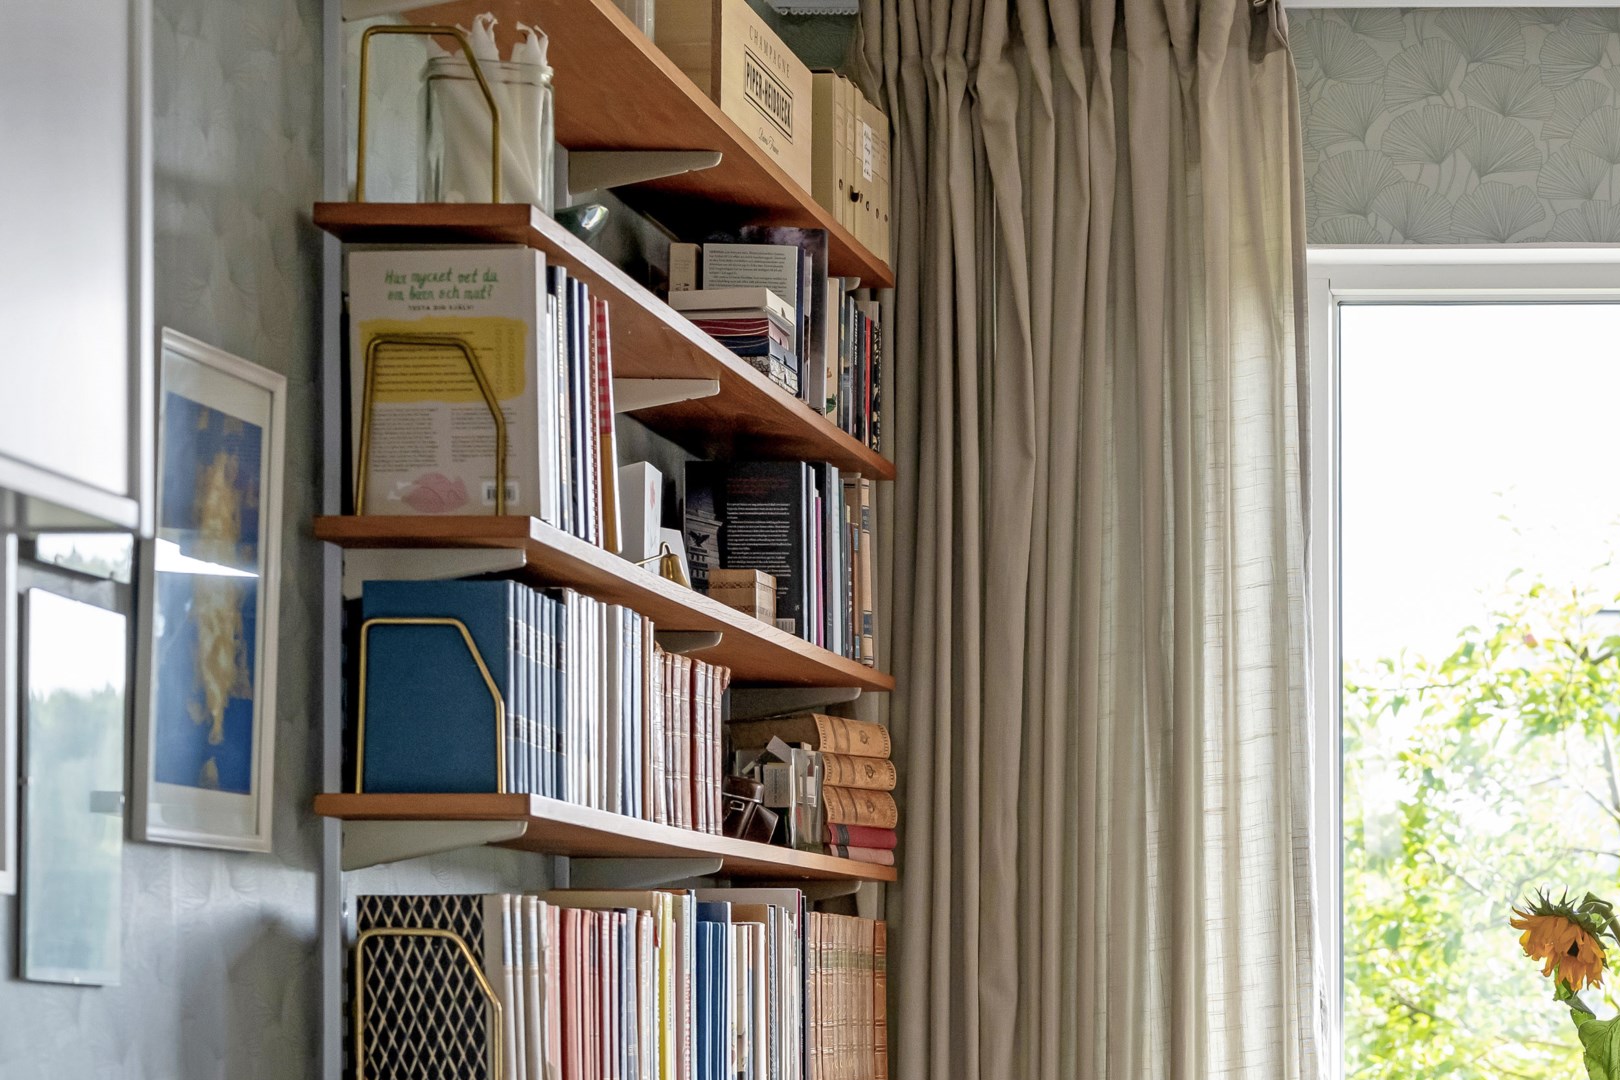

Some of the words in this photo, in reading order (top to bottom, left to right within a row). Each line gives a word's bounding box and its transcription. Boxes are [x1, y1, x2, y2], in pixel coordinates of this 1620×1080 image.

[749, 25, 790, 78] CHAMPAGNE
[746, 61, 791, 129] PIPER-HEIDSIECK
[384, 268, 407, 285] Hur
[411, 267, 453, 289] mycket
[482, 267, 498, 282] du
